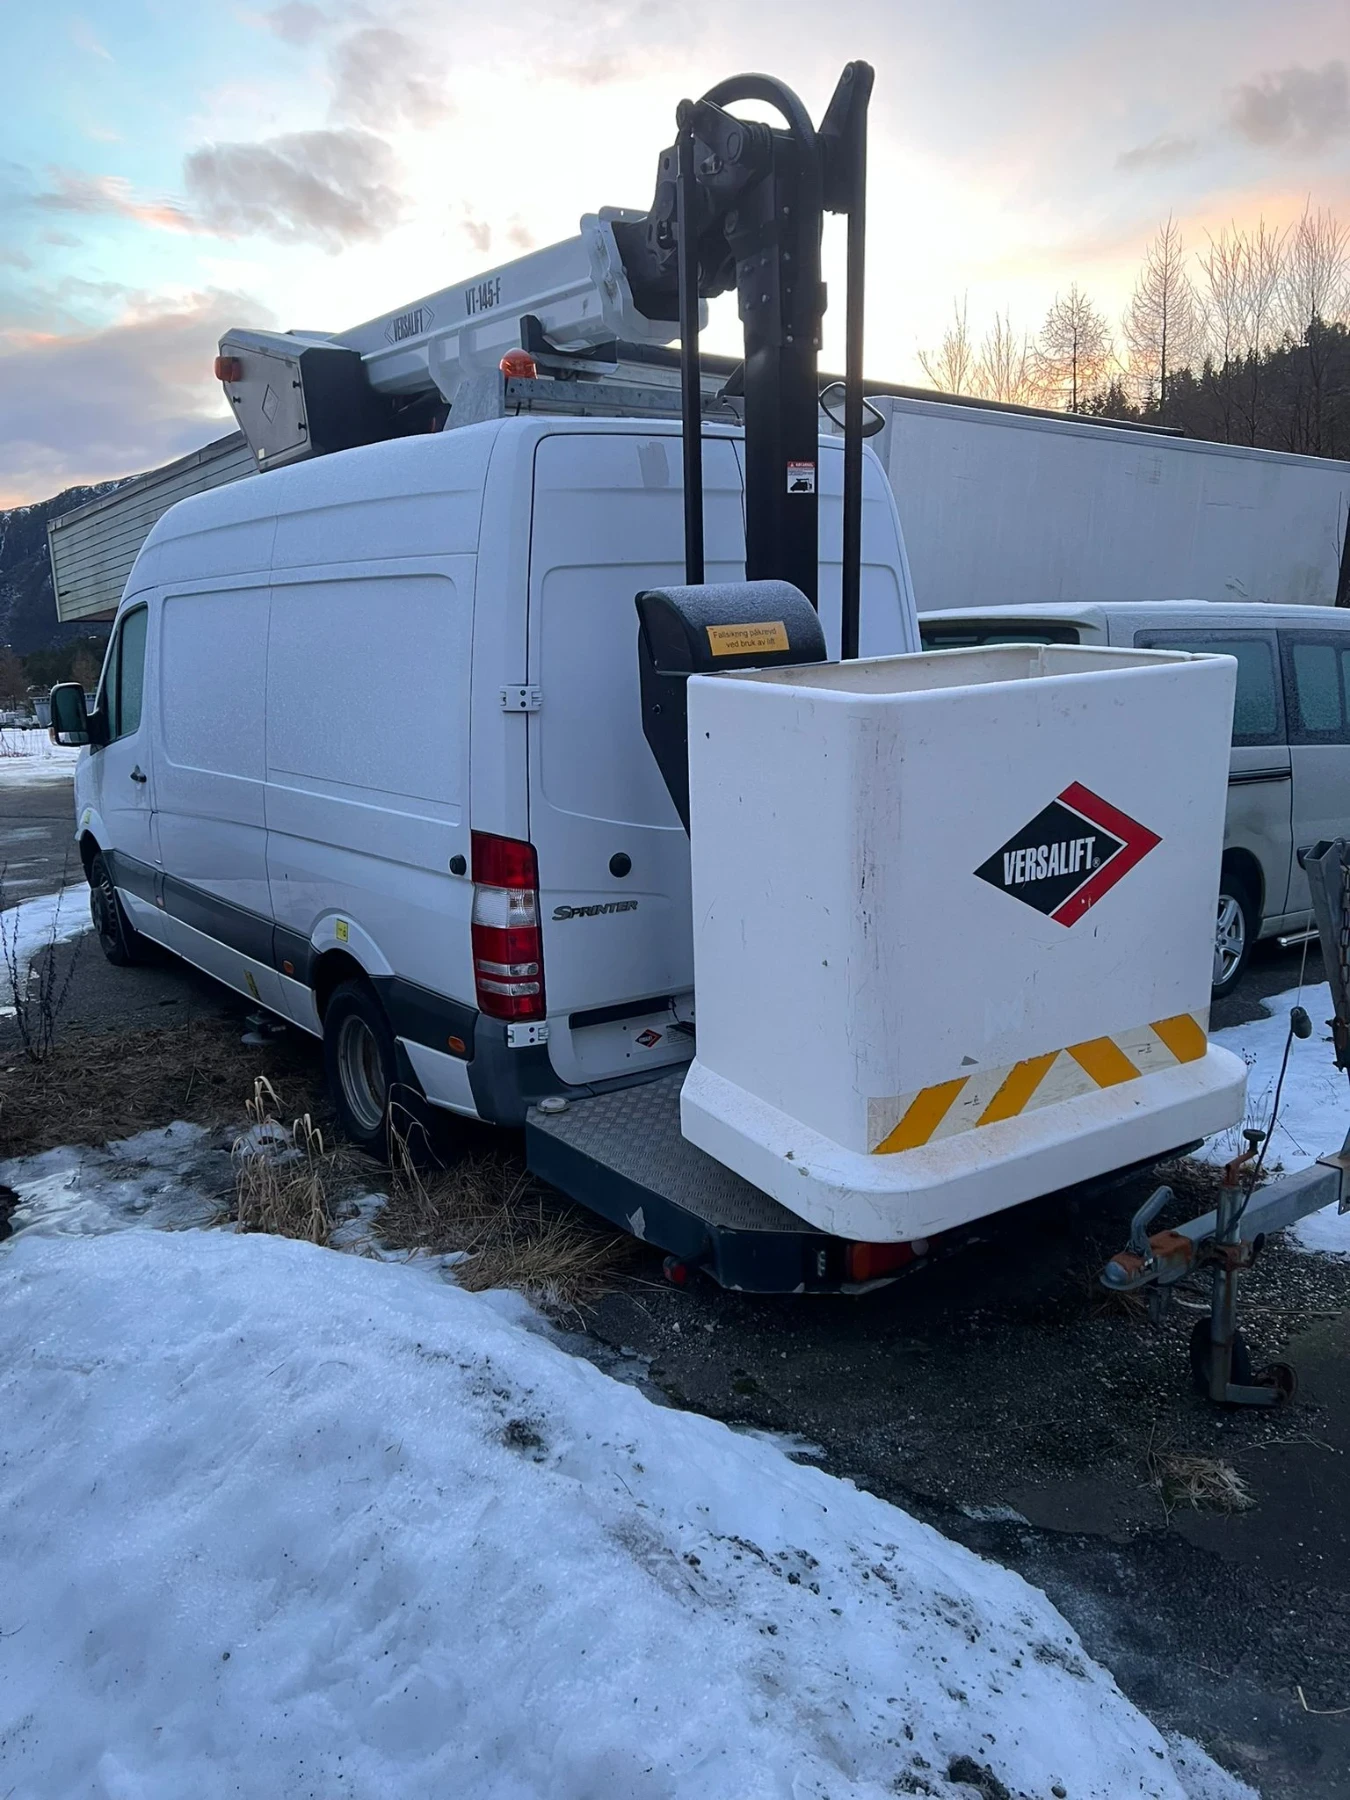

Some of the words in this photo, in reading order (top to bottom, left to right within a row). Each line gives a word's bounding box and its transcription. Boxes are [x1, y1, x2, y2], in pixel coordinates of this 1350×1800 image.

[465, 277, 501, 316] VT-145-F
[393, 308, 423, 342] VERSALIFT
[726, 640, 739, 648] ved
[741, 639, 755, 648] bruk
[1003, 836, 1096, 886] VERSALIFT
[551, 900, 639, 921] SPRINTER
